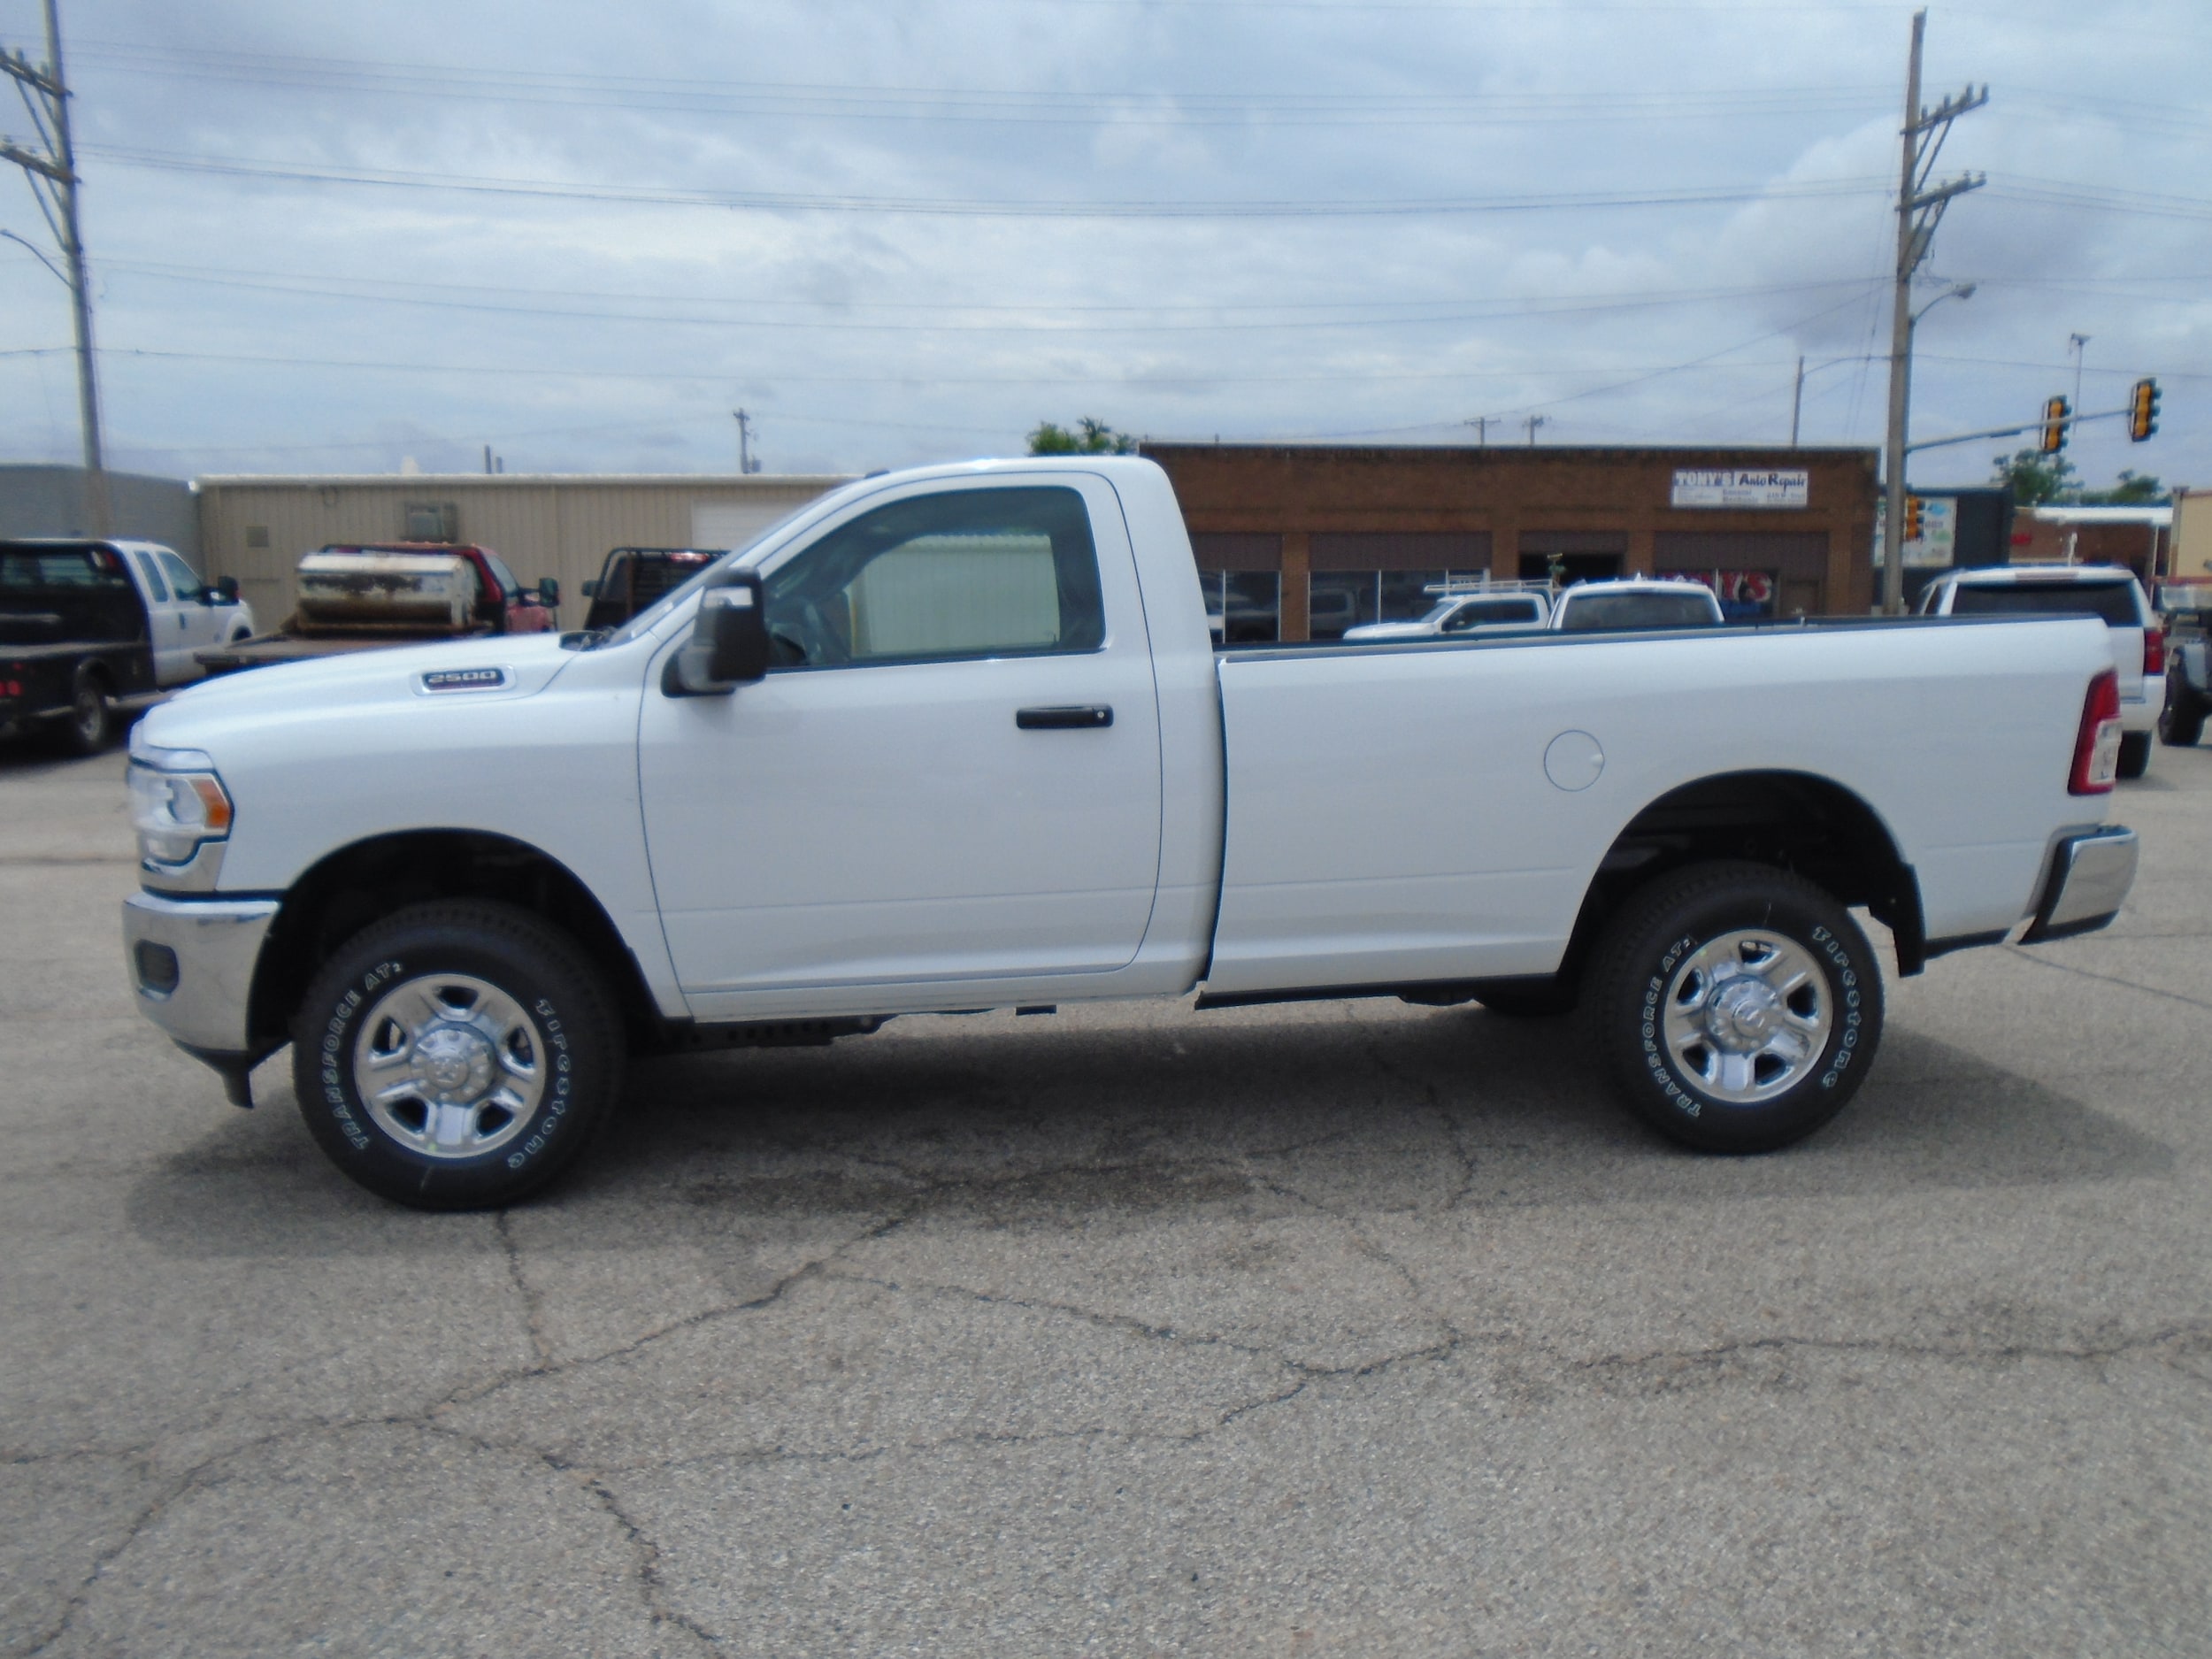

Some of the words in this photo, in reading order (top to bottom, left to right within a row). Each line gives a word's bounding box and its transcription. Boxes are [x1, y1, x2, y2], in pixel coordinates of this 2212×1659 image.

[1676, 471, 1732, 487] TONY'S
[1739, 472, 1767, 487] Auto
[1768, 472, 1806, 492] Repair
[427, 670, 497, 684] 2500
[321, 989, 370, 1149] TRANSFORCE
[1642, 976, 1701, 1118] TRANSFORCE
